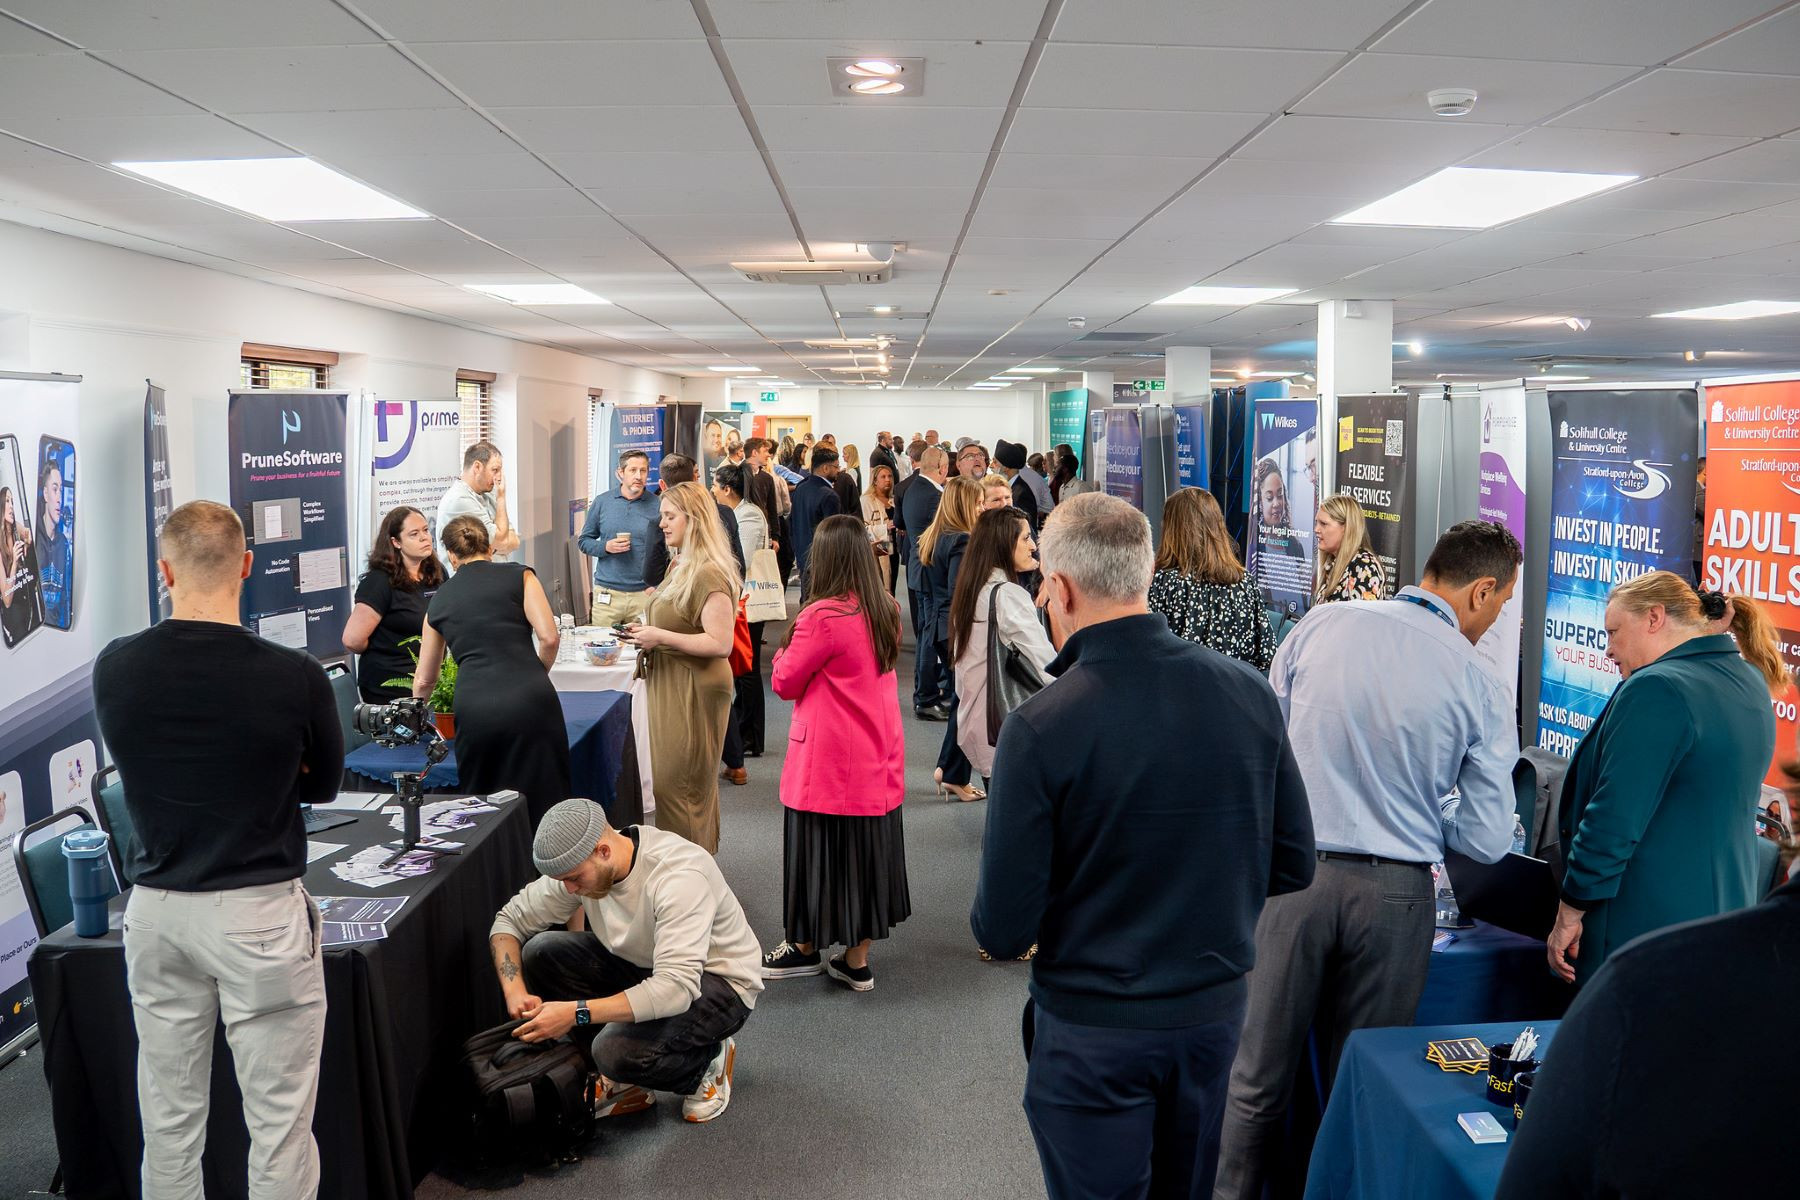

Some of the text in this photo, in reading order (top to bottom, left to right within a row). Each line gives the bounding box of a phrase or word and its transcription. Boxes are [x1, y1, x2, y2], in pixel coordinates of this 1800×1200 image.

[422, 411, 459, 431] prime
[622, 414, 654, 424] INTERNET
[1274, 416, 1298, 428] Wilkes
[1725, 405, 1800, 425] Solihull College
[623, 426, 655, 436] & PHONES
[1569, 426, 1628, 444] Solihull College
[1724, 426, 1799, 443] & University Centre
[1569, 442, 1627, 456] & University Centre
[241, 450, 343, 469] PruneSoftware
[1741, 458, 1800, 476] Stratford-upon-
[250, 474, 266, 482] Prune
[1349, 463, 1385, 483] FLEXIBLE
[1584, 467, 1645, 481] Stratford-upon-Avon
[1620, 480, 1644, 490] College
[1341, 485, 1392, 507] HR SERVICES
[303, 501, 321, 509] Complex
[1379, 512, 1401, 522] RETAINED
[1259, 524, 1310, 538] Your legal partner
[1259, 534, 1267, 544] for
[1554, 516, 1664, 555] INVEST IN PEOPLE.
[1707, 508, 1800, 556] ADULT
[265, 566, 291, 575] Automation
[1554, 550, 1656, 586] INVEST IN SKI
[757, 582, 779, 590] Wilkes
[1705, 555, 1800, 607] SKILLS
[308, 605, 334, 614] Personalised
[1546, 618, 1607, 651] SUPERC
[1555, 645, 1585, 665] YOUR
[1540, 702, 1554, 722] ASK
[1555, 707, 1567, 725] US
[0, 937, 37, 964] Place or Ours
